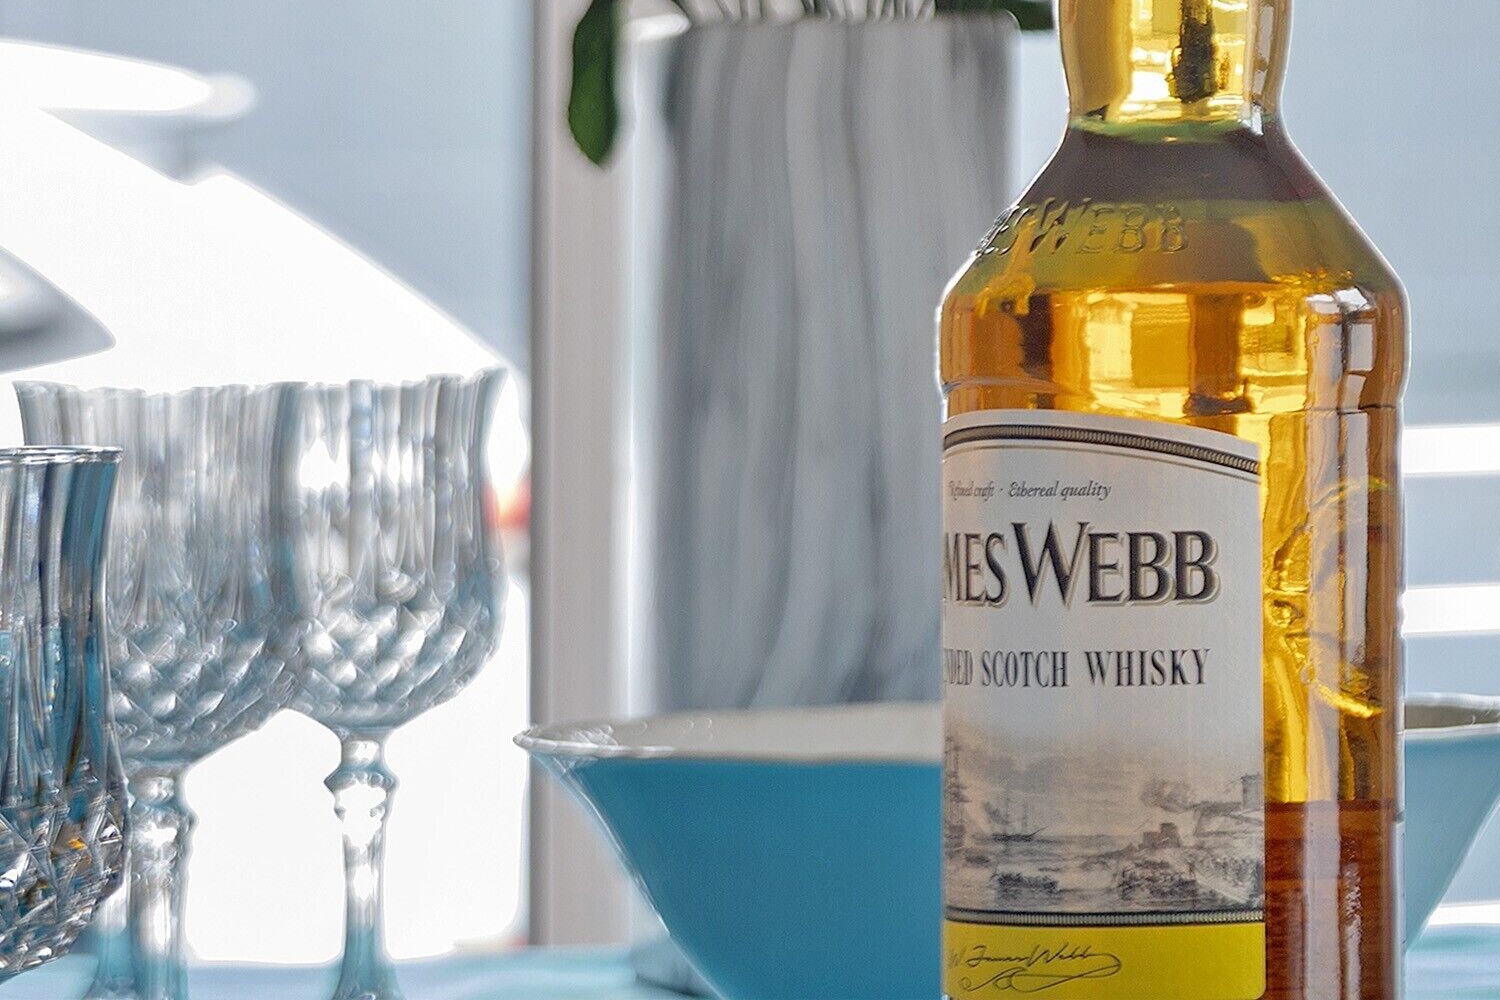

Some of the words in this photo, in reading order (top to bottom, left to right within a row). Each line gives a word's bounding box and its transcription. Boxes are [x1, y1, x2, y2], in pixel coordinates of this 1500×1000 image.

[1008, 480, 1060, 498] Ethereal
[1060, 480, 1112, 501] quality
[981, 650, 1069, 688] SCOTCH
[1084, 647, 1211, 687] WHISKY
